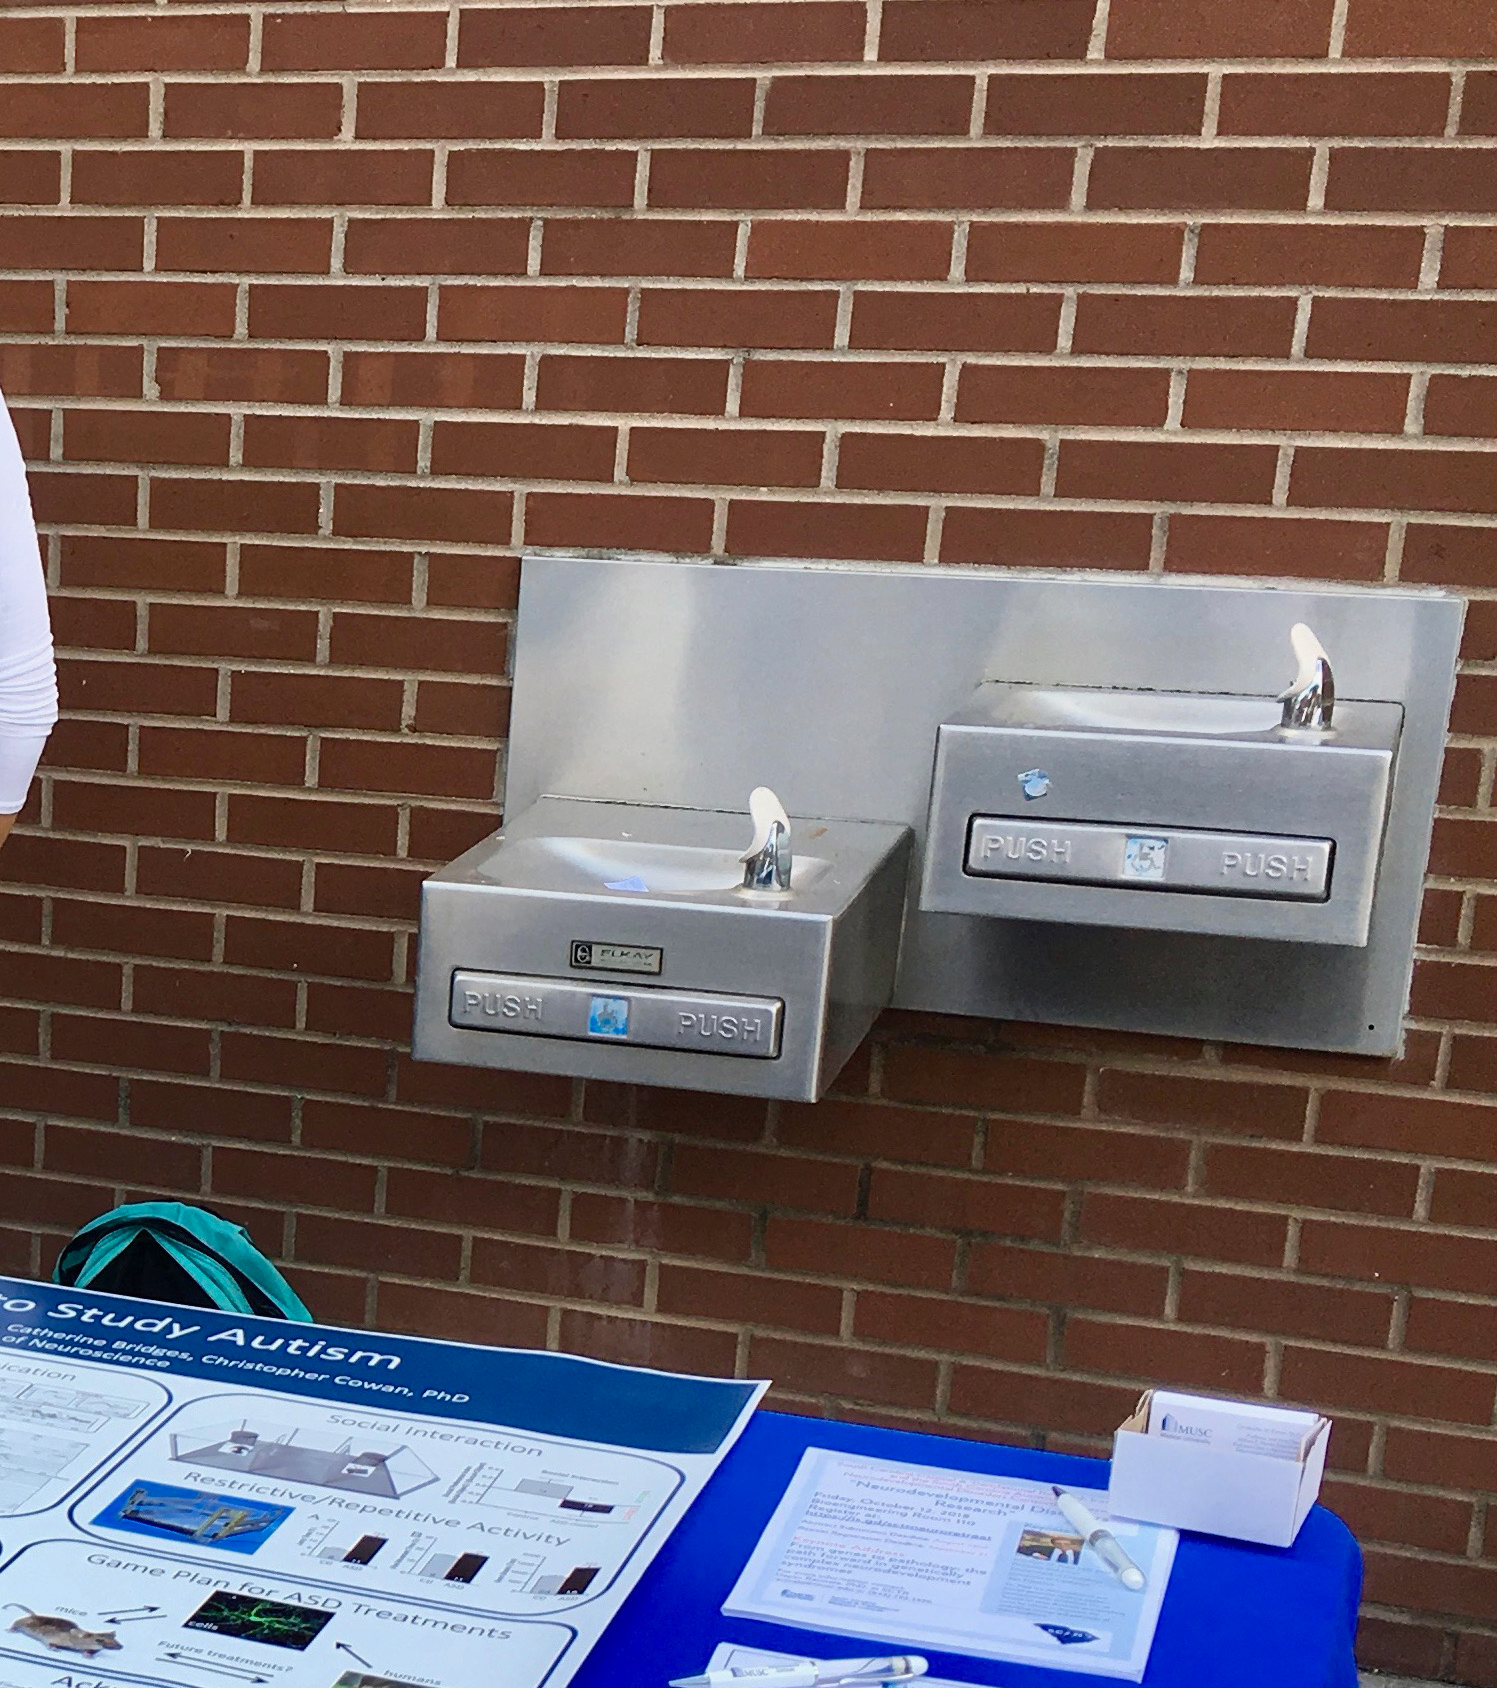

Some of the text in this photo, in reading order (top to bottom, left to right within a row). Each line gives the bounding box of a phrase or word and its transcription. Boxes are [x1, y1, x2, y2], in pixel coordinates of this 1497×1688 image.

[982, 835, 1313, 881] PUSH PUSH
[463, 990, 761, 1041] PUSH PUSH
[2, 1333, 29, 1345] of
[28, 1338, 171, 1369] Neuroscience
[47, 1303, 200, 1339] Study
[207, 1327, 403, 1371] Autism
[7, 1323, 107, 1347] Catherine
[111, 1340, 195, 1363] Bridges,
[201, 1354, 330, 1383] Christopher
[334, 1375, 414, 1398] Cowan,
[422, 1389, 471, 1404] PhD
[326, 1414, 544, 1458] Social Interaction
[1178, 1424, 1213, 1439] MUSC
[182, 1470, 462, 1531] Restrictive/Repetitive
[466, 1520, 572, 1547] Activity
[811, 1498, 908, 1519] Bioengineering
[912, 1511, 952, 1523] Room
[860, 1498, 916, 1511] October
[784, 1555, 839, 1570] complex
[789, 1542, 825, 1552] From
[827, 1548, 867, 1559] genes
[965, 1567, 988, 1576] the
[820, 1552, 872, 1566] forward
[890, 1563, 965, 1580] genetically
[54, 1605, 89, 1617] mice
[86, 1553, 513, 1641] Game Plan for ASD Treatments
[188, 1620, 219, 1631] cells
[157, 1639, 294, 1673] Future treatments?
[382, 1669, 442, 1687] humans
